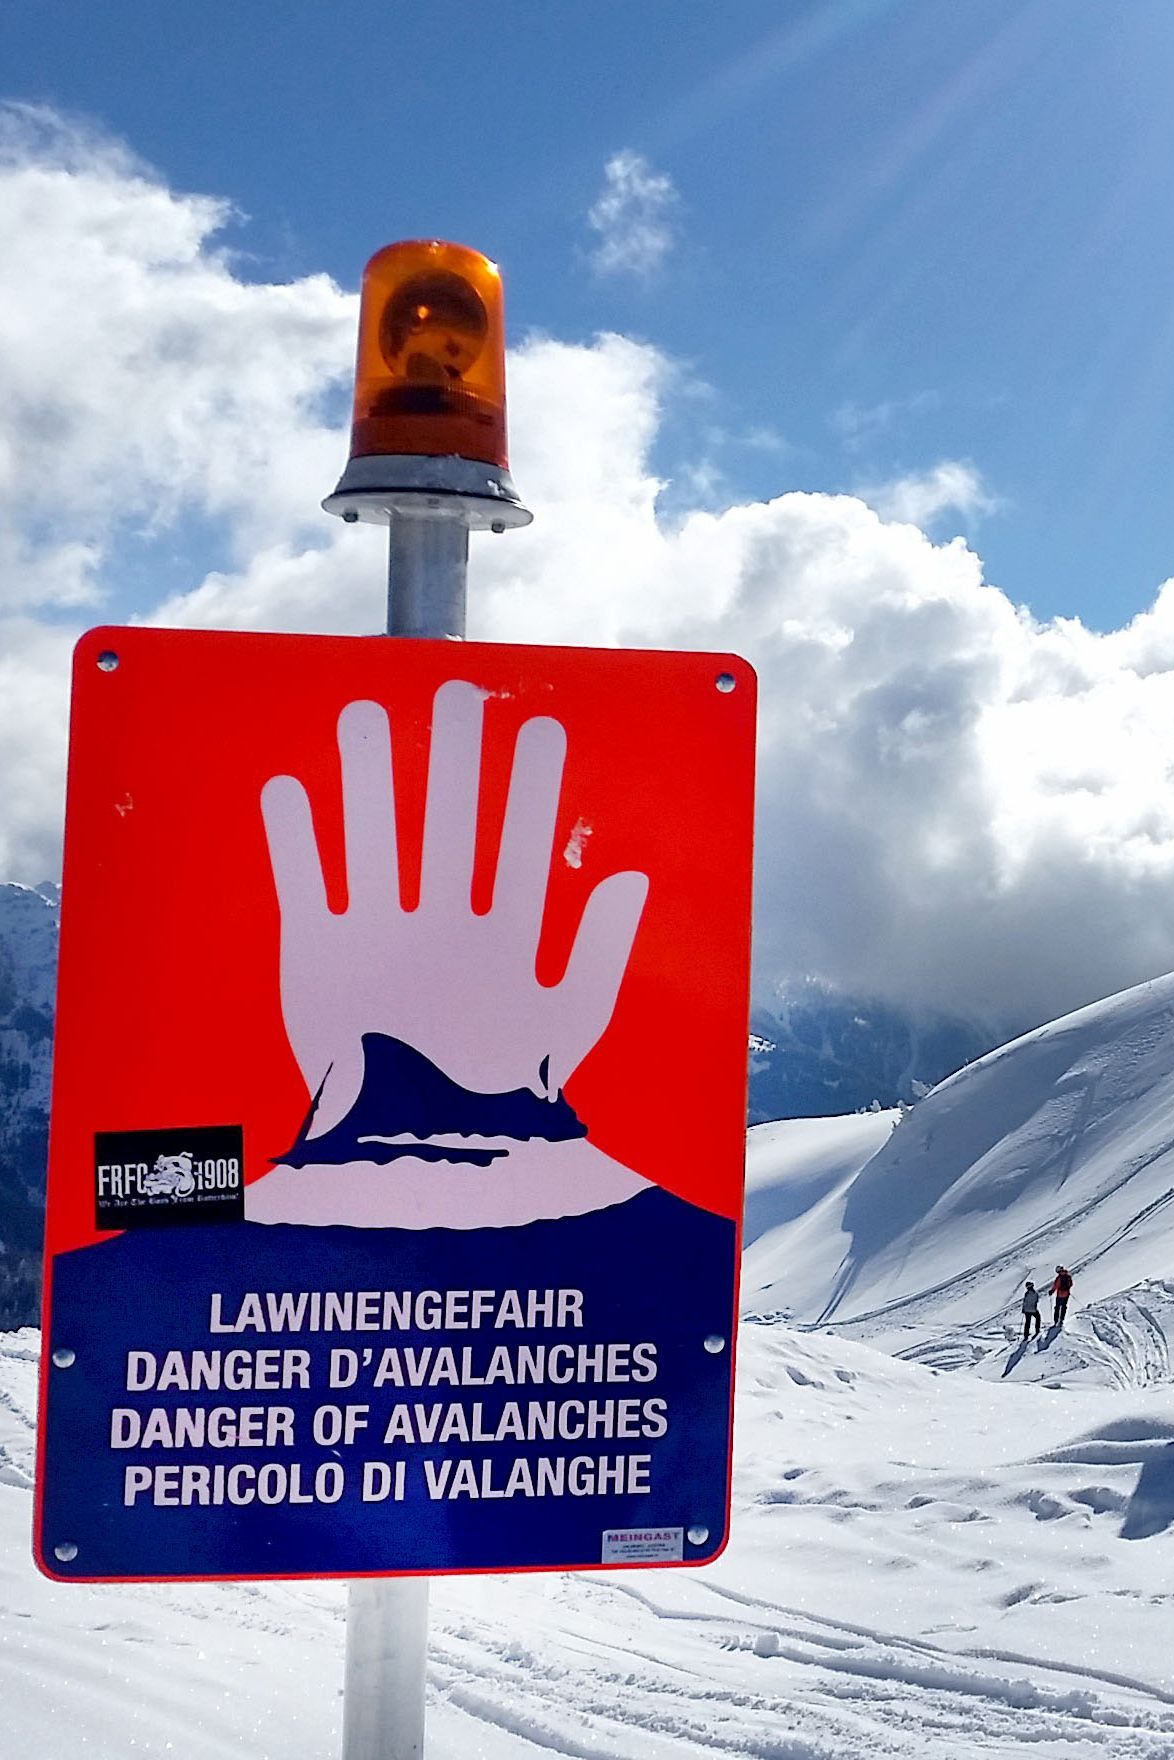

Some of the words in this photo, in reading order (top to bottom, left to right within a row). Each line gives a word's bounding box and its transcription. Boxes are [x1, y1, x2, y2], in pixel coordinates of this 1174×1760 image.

[97, 1163, 148, 1198] FRFC
[194, 1158, 239, 1190] 1908
[211, 1290, 583, 1332] LAWINENGEFAHR
[127, 1350, 310, 1390] DANGER
[330, 1343, 657, 1387] D'AVALANCHES
[111, 1407, 294, 1448] DANGER
[314, 1405, 369, 1445] OF
[384, 1399, 667, 1443] AVALANCHES
[125, 1463, 344, 1505] PERICOLO
[363, 1462, 405, 1501] DI
[424, 1455, 651, 1499] VALANGHE
[607, 1532, 681, 1543] MEINGAST
